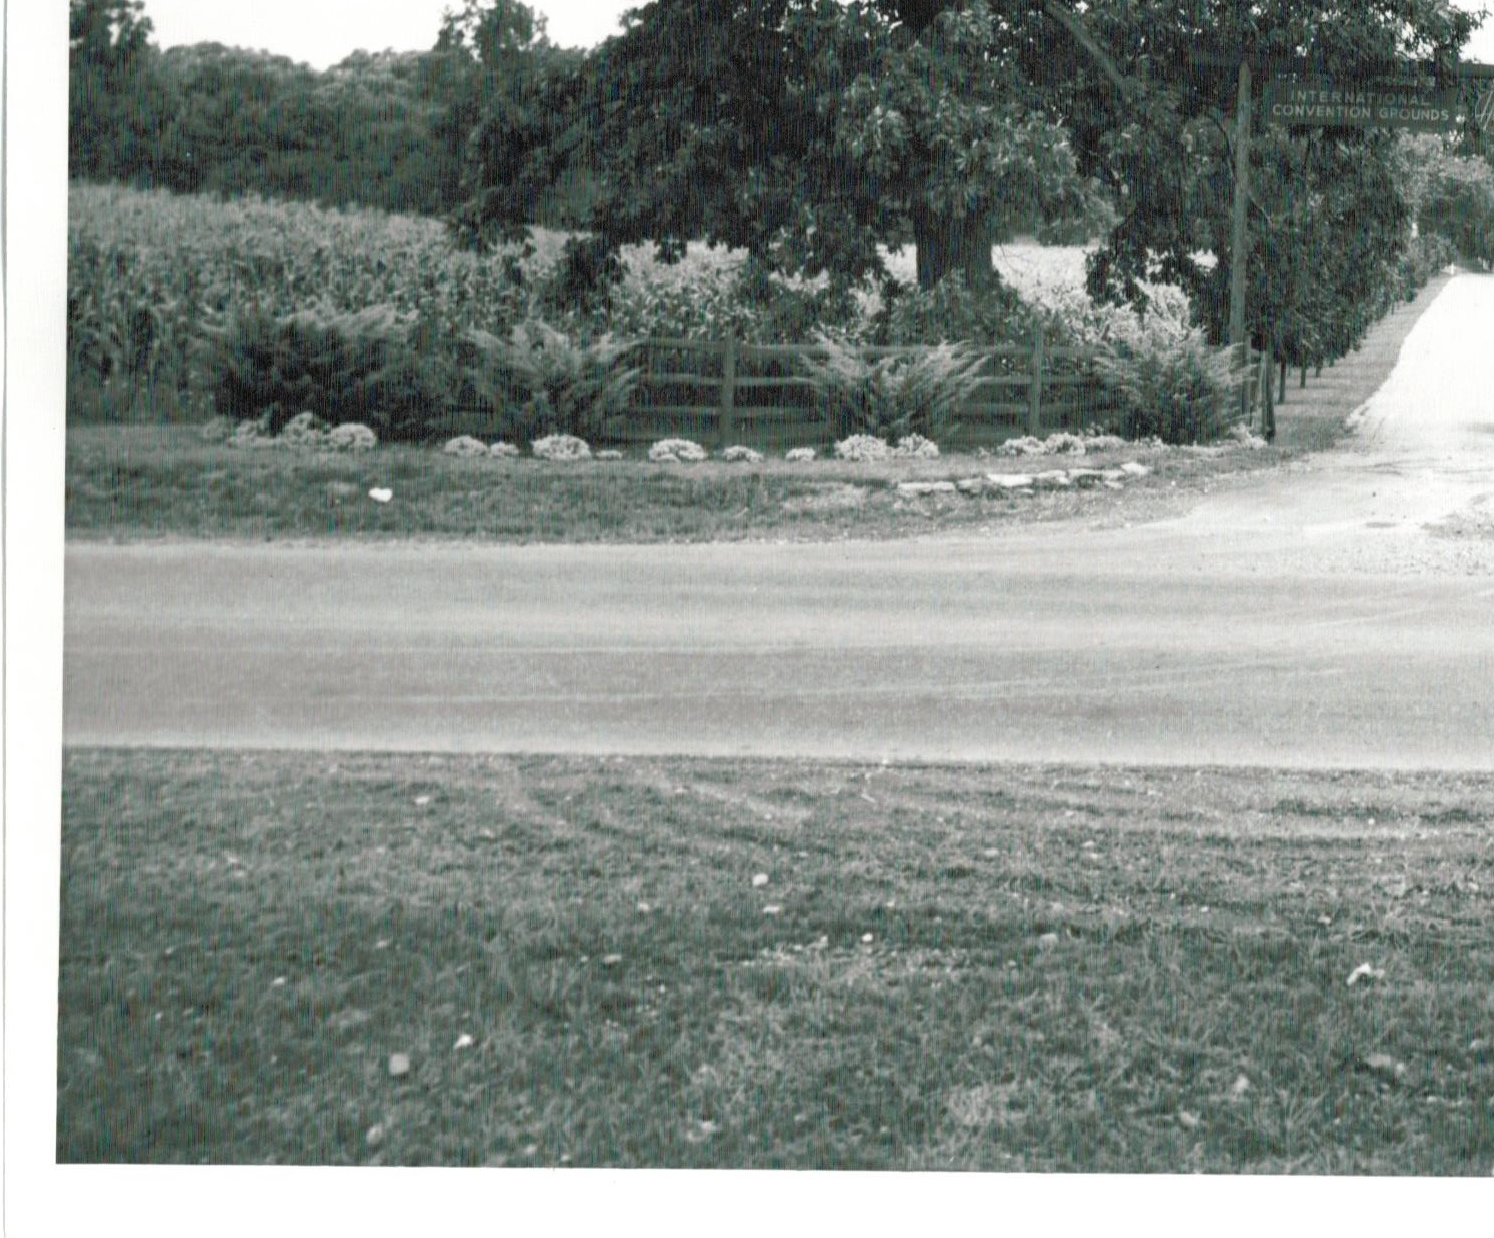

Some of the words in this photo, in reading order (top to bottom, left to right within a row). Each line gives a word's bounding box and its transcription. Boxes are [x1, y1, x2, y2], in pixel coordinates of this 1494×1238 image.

[1291, 89, 1431, 106] INTERNATIONAL
[1272, 103, 1371, 119] CONVENTION
[1379, 106, 1449, 122] GROUNDS
